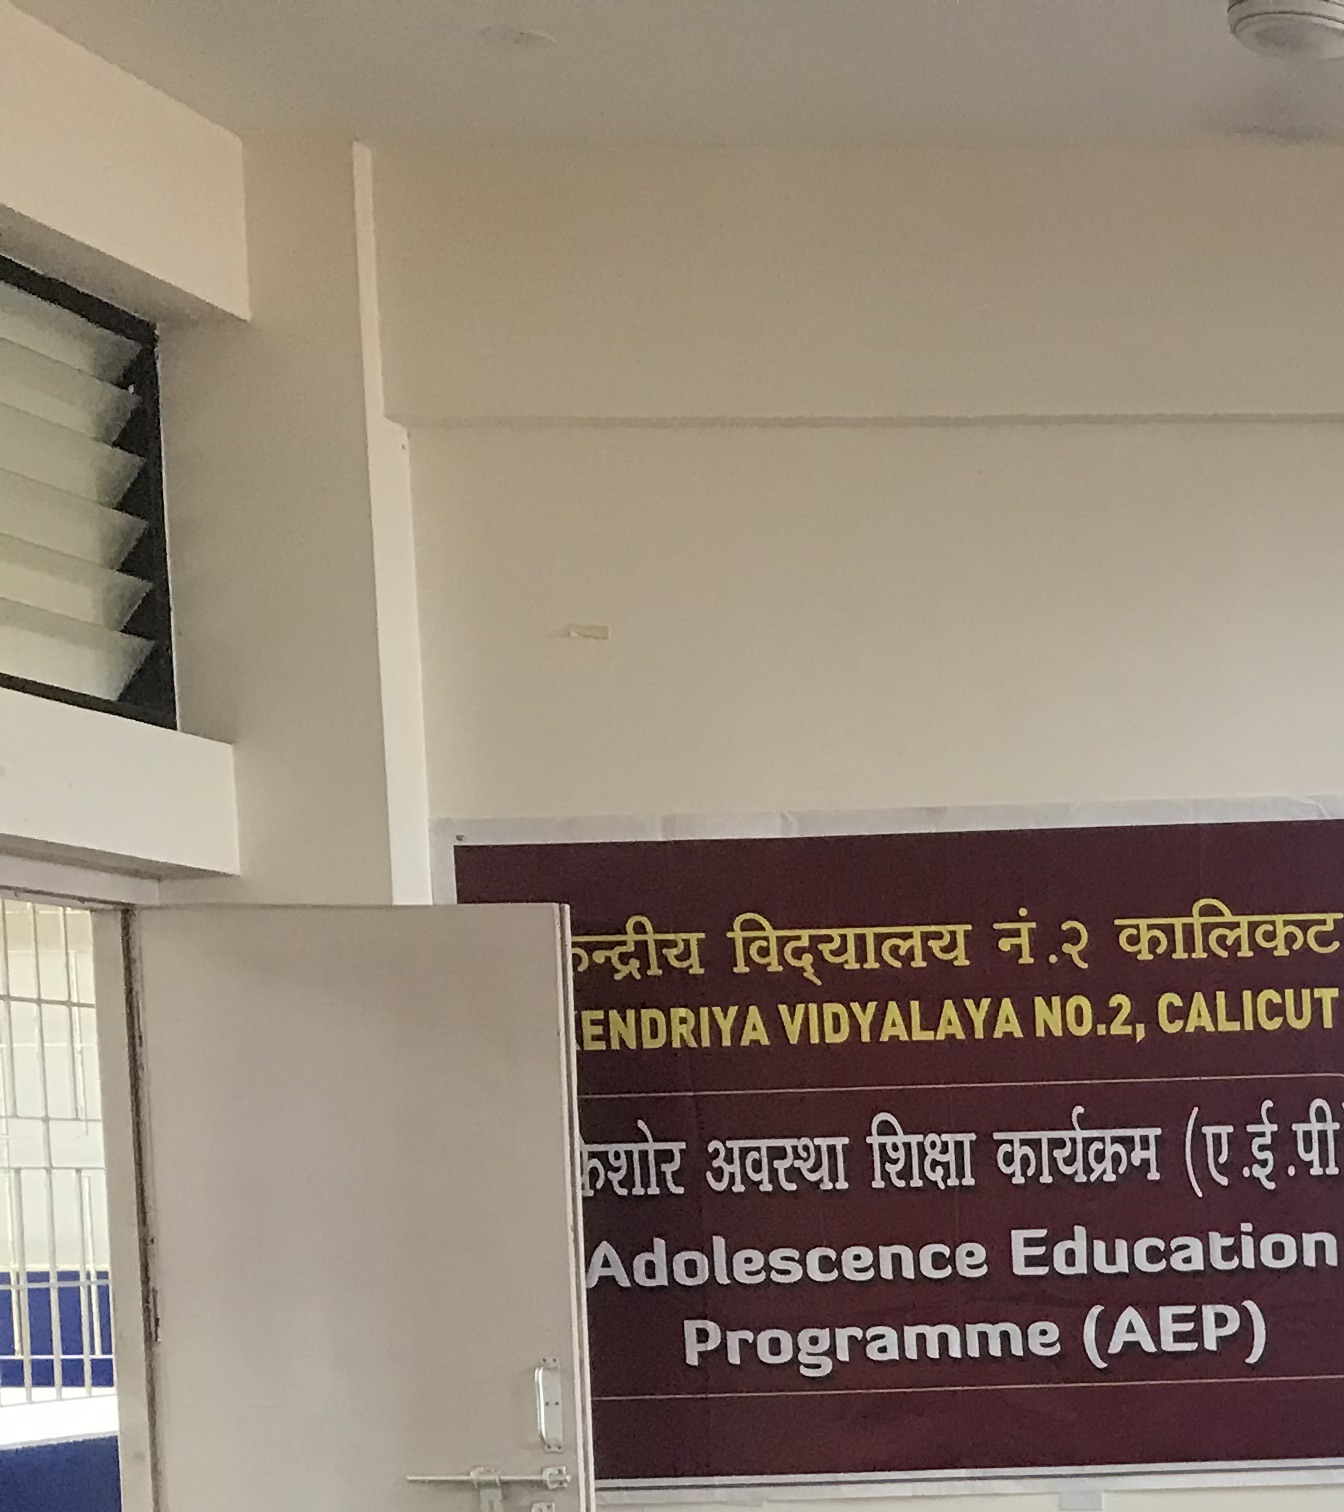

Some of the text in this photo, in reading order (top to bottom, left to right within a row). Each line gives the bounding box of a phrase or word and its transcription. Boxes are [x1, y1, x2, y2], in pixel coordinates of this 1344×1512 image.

[571, 915, 706, 980] न्द्रीय
[1113, 897, 1344, 961] कालिकट
[576, 987, 1340, 1051] ENDRIYA VIDYALAYA NO.2, CALICUT
[705, 1136, 850, 1193] अवस्था
[865, 1112, 977, 1190] शिक्षा
[992, 1105, 1163, 1185] कार्यक्रम
[586, 1222, 1338, 1289] Adolescence Education
[683, 1299, 1267, 1378] Programme (AEP)
